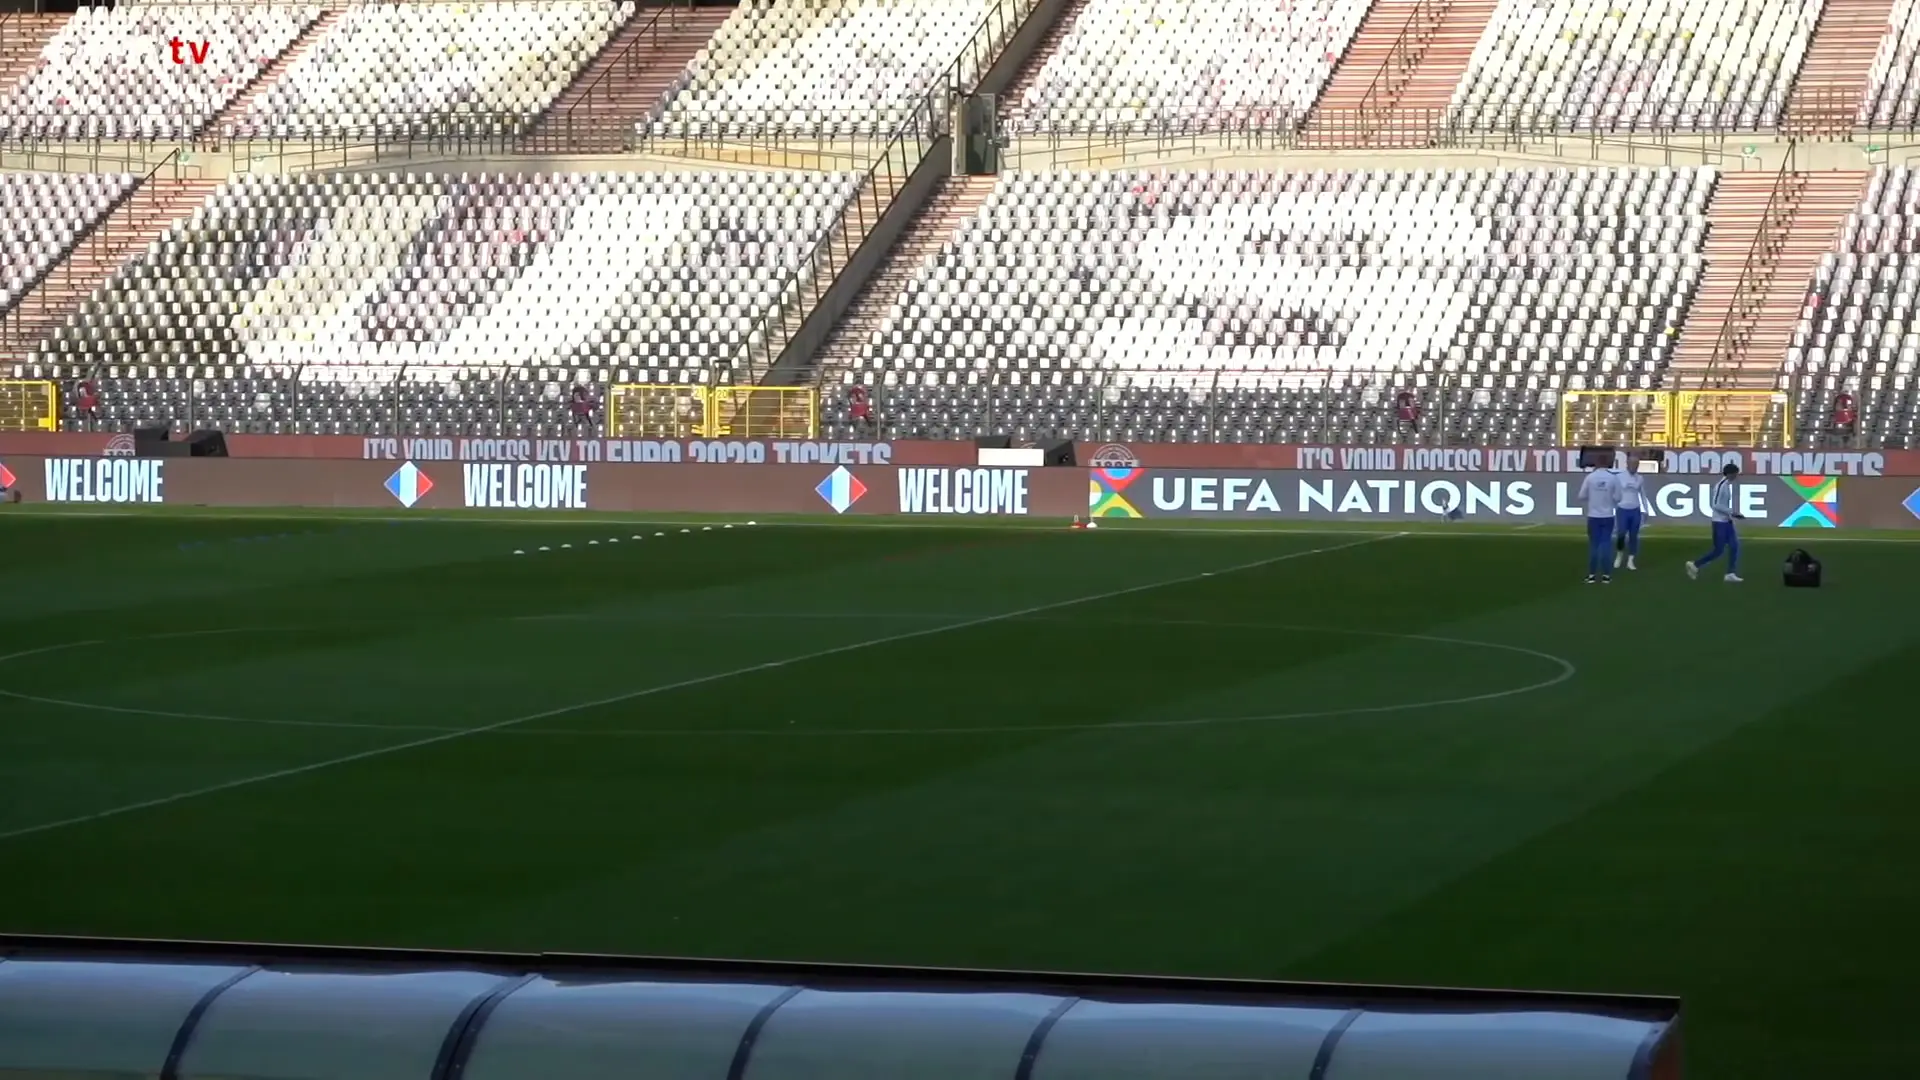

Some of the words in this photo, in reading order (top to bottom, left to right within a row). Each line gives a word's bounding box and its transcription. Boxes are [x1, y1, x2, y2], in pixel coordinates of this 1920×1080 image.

[45, 458, 164, 503] WELCOME
[463, 463, 588, 509] WELCOME
[898, 467, 1028, 515] WELCOME
[1152, 477, 1282, 513] UEFA
[1298, 478, 1536, 518] NATIONS
[1556, 481, 1768, 519] LGUE
